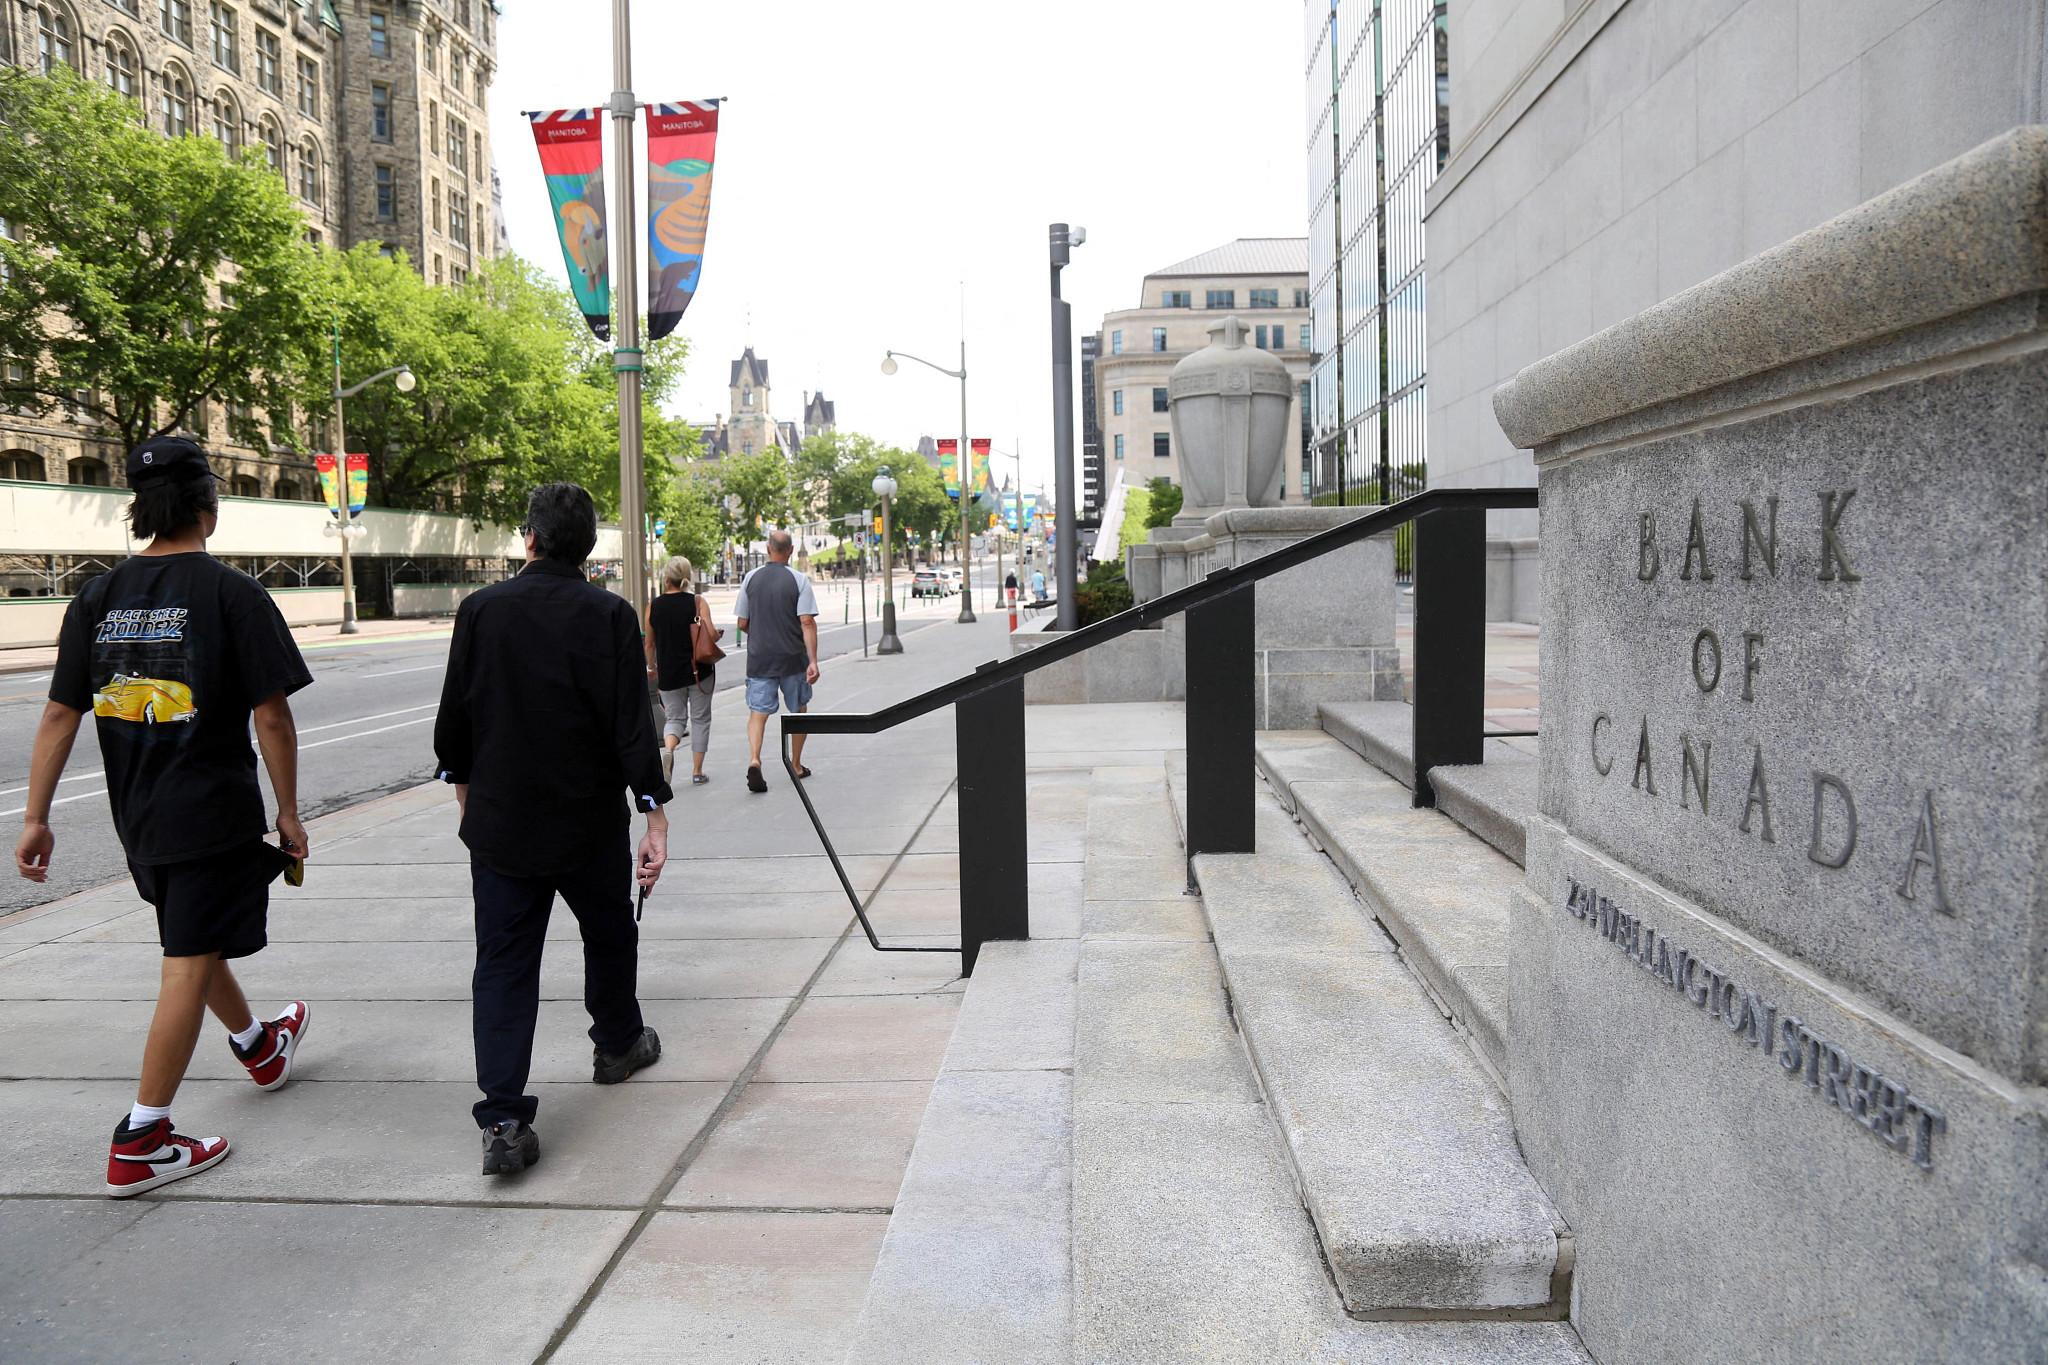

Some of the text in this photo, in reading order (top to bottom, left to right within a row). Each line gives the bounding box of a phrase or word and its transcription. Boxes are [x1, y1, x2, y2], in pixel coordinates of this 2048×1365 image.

[548, 127, 587, 137] MANITOBA
[662, 120, 704, 131] MANITOBA
[1638, 488, 1862, 582] BANK
[106, 609, 152, 621] BLACK
[1692, 629, 1764, 702] OF
[1591, 711, 1957, 919] CANADA
[1598, 896, 1777, 1057] WELLINGTON
[1779, 1015, 1947, 1174] STREET
